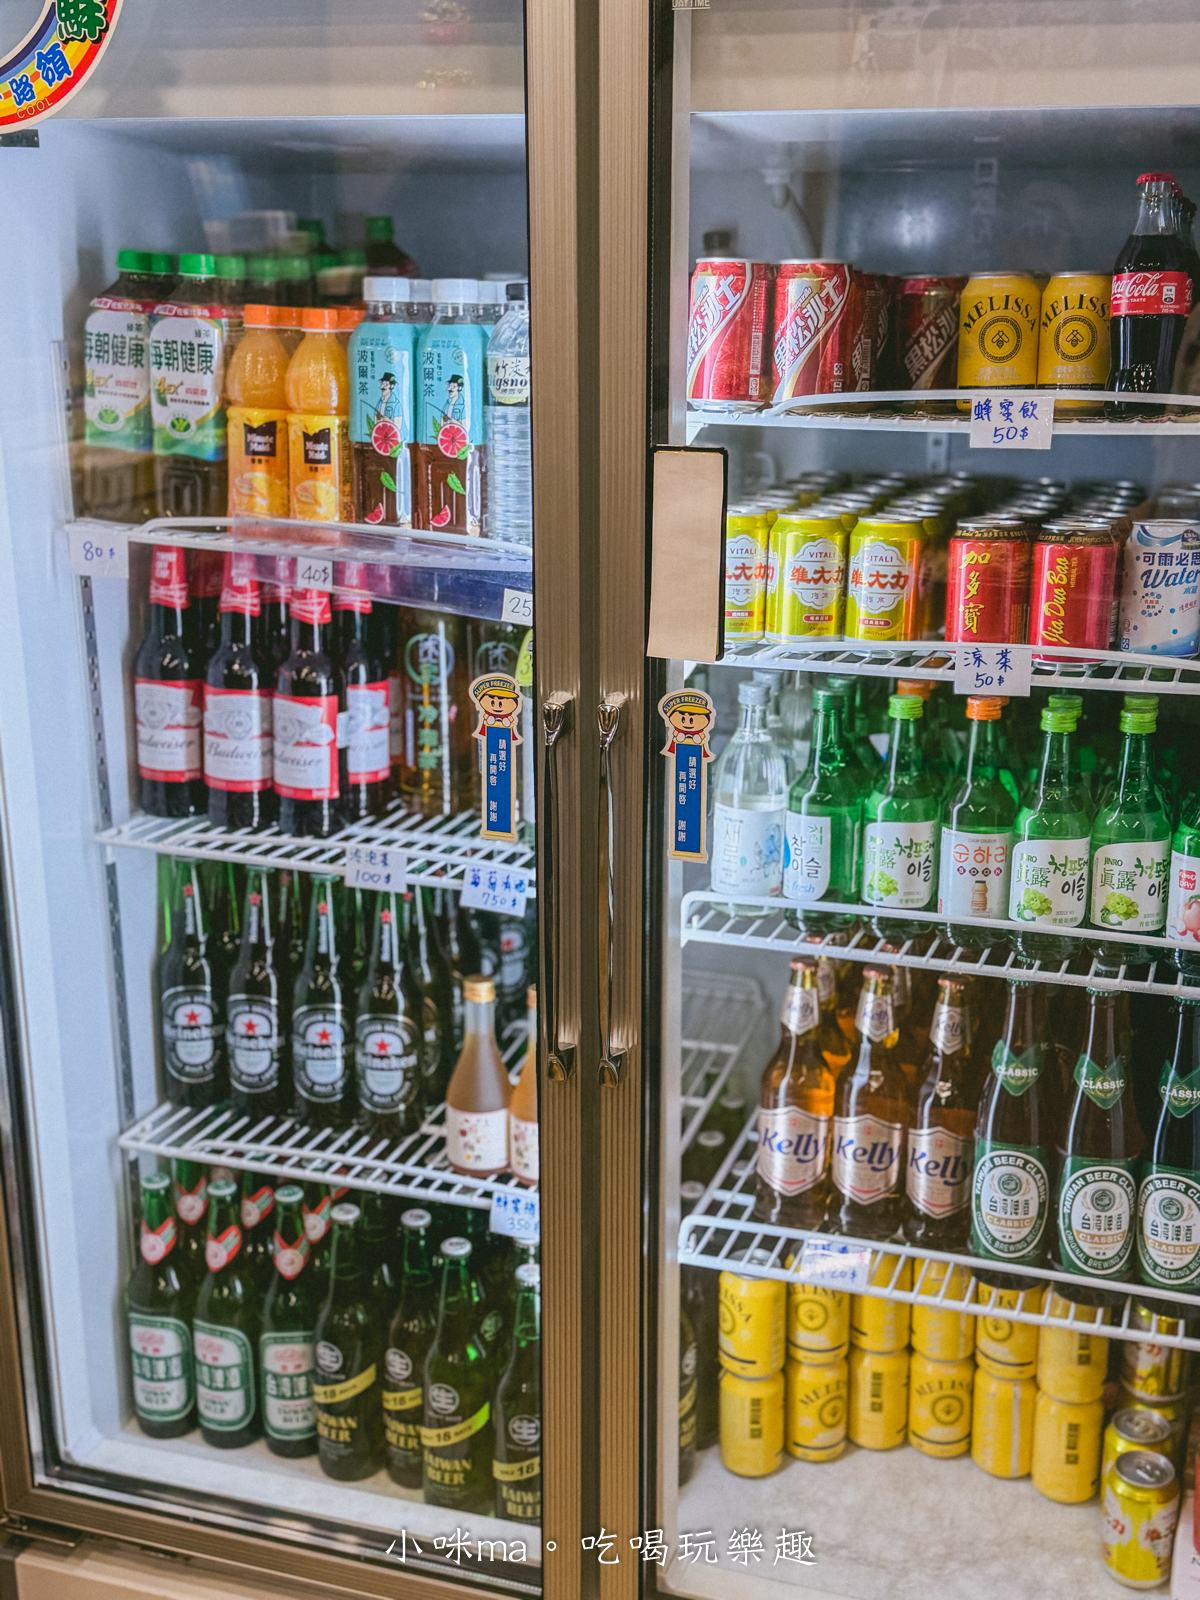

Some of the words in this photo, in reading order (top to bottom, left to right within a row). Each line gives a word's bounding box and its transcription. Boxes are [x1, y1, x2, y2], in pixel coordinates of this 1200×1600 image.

[17, 97, 53, 118] COOL
[963, 294, 1036, 334] MELISSA
[774, 274, 844, 379] 黑松沙士
[151, 339, 214, 375] 每朝健康
[357, 350, 369, 395] 波爾茶
[422, 351, 435, 397] 波爾茶
[973, 398, 1039, 423] 蜂蜜飲
[992, 426, 1029, 444] 50$
[83, 541, 115, 561] 80$
[809, 551, 836, 559] VITALI
[865, 555, 893, 563] VITALI
[1142, 551, 1200, 566] 可爾必思
[301, 565, 330, 583] 40$
[725, 561, 768, 581] 大力
[1047, 556, 1070, 585] Bao
[1140, 567, 1200, 589] Water
[958, 550, 991, 634] 加多寶
[1044, 587, 1067, 617] Duo
[1041, 619, 1071, 645] Jia
[963, 647, 1013, 673] 涼茶
[474, 682, 490, 696] SUPER
[490, 680, 513, 691] FREEZER
[974, 672, 1005, 688] 50$
[663, 697, 681, 712] SUPER
[681, 696, 707, 707] FREEZER
[499, 739, 507, 772] 請選好
[688, 756, 697, 790] 請選好
[953, 843, 1008, 864] 순하리
[1104, 857, 1123, 867] JINRO
[355, 869, 391, 885] 100$
[907, 854, 932, 883] 이슬
[1061, 873, 1085, 901] 이슬
[996, 1064, 1038, 1077] CLASSIC
[1082, 1078, 1124, 1089] CLASSIC
[1160, 1085, 1200, 1099] CLASSIC
[763, 1128, 825, 1163] Kelly
[836, 1135, 901, 1172] Kelly
[975, 1159, 994, 1195] TAIWAN
[993, 1156, 1025, 1167] BEER
[1025, 1163, 1046, 1203] CLASSIC
[1154, 1179, 1186, 1192] BEER
[1063, 1178, 1086, 1213] TAIWAN
[1085, 1172, 1118, 1182] BEER
[986, 1215, 1032, 1227] CLASSIC
[994, 1240, 1027, 1252] BREWING
[1079, 1233, 1123, 1243] CLASSIC
[1148, 1239, 1194, 1253] CLASSIC
[1065, 1230, 1086, 1262] ORIGINAL
[1087, 1257, 1120, 1268] BREWING
[1155, 1266, 1190, 1278] BREWING
[516, 1462, 535, 1475] 18
